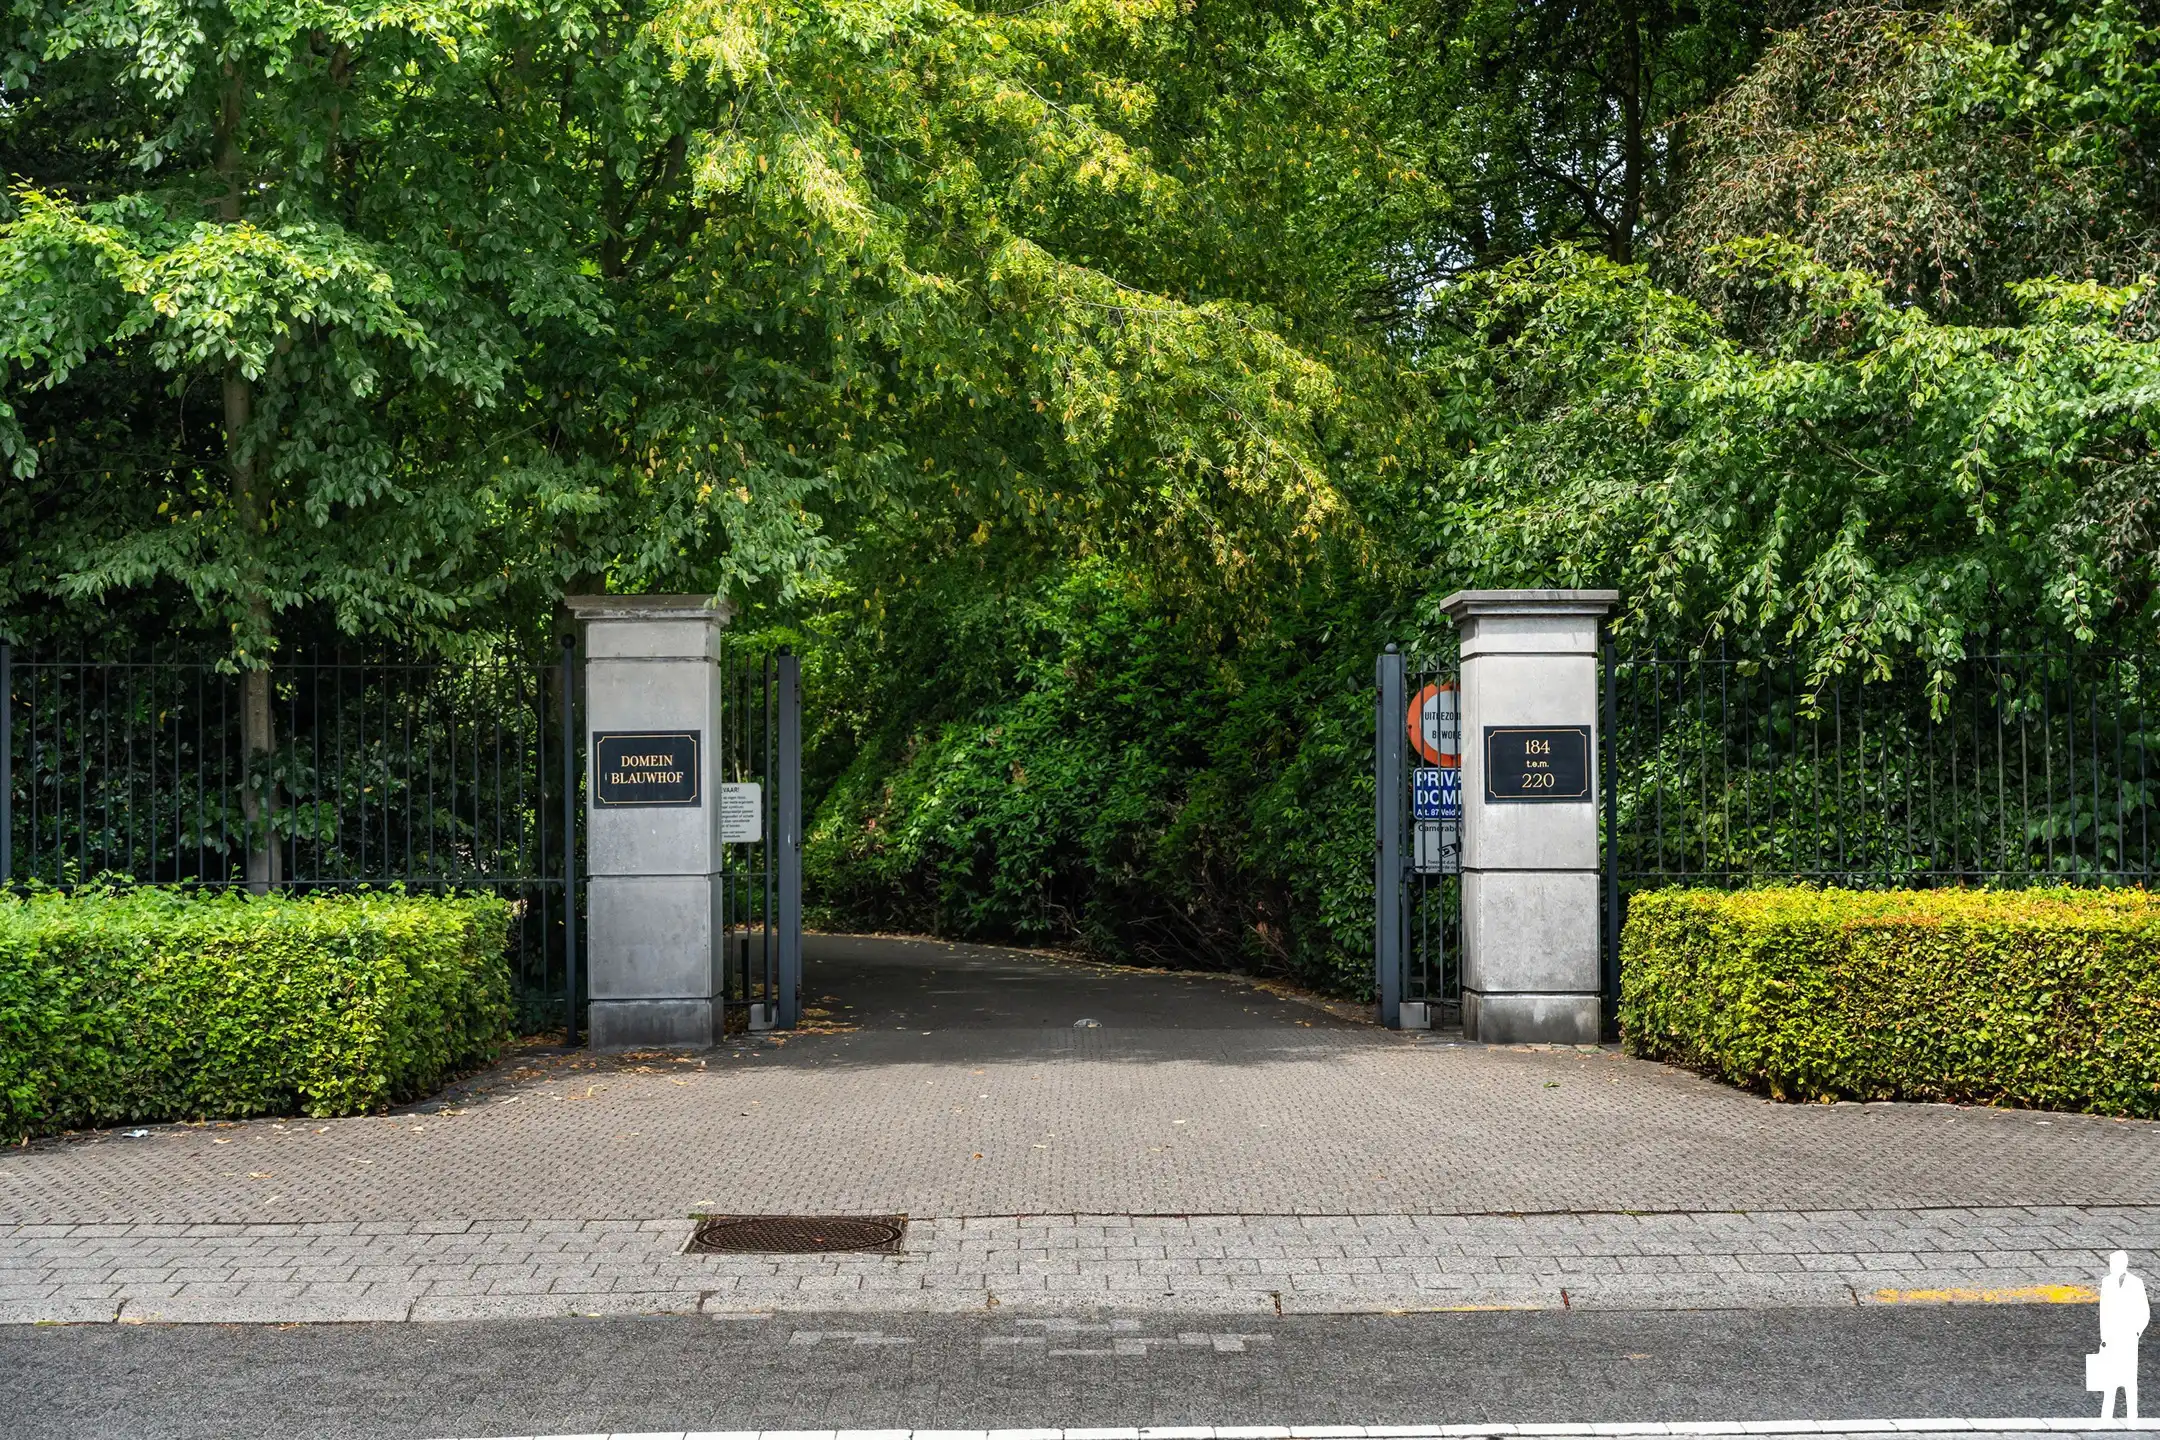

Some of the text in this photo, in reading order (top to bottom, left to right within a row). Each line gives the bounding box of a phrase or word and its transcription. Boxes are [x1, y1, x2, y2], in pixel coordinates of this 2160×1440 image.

[1525, 739, 1551, 755] 184
[621, 755, 673, 767] DOMEIN
[1526, 760, 1550, 768] t.e.m.
[611, 772, 684, 784] BLAUWHOF
[1522, 772, 1555, 788] 220
[1416, 808, 1430, 816] At.
[1430, 808, 1439, 816] 87
